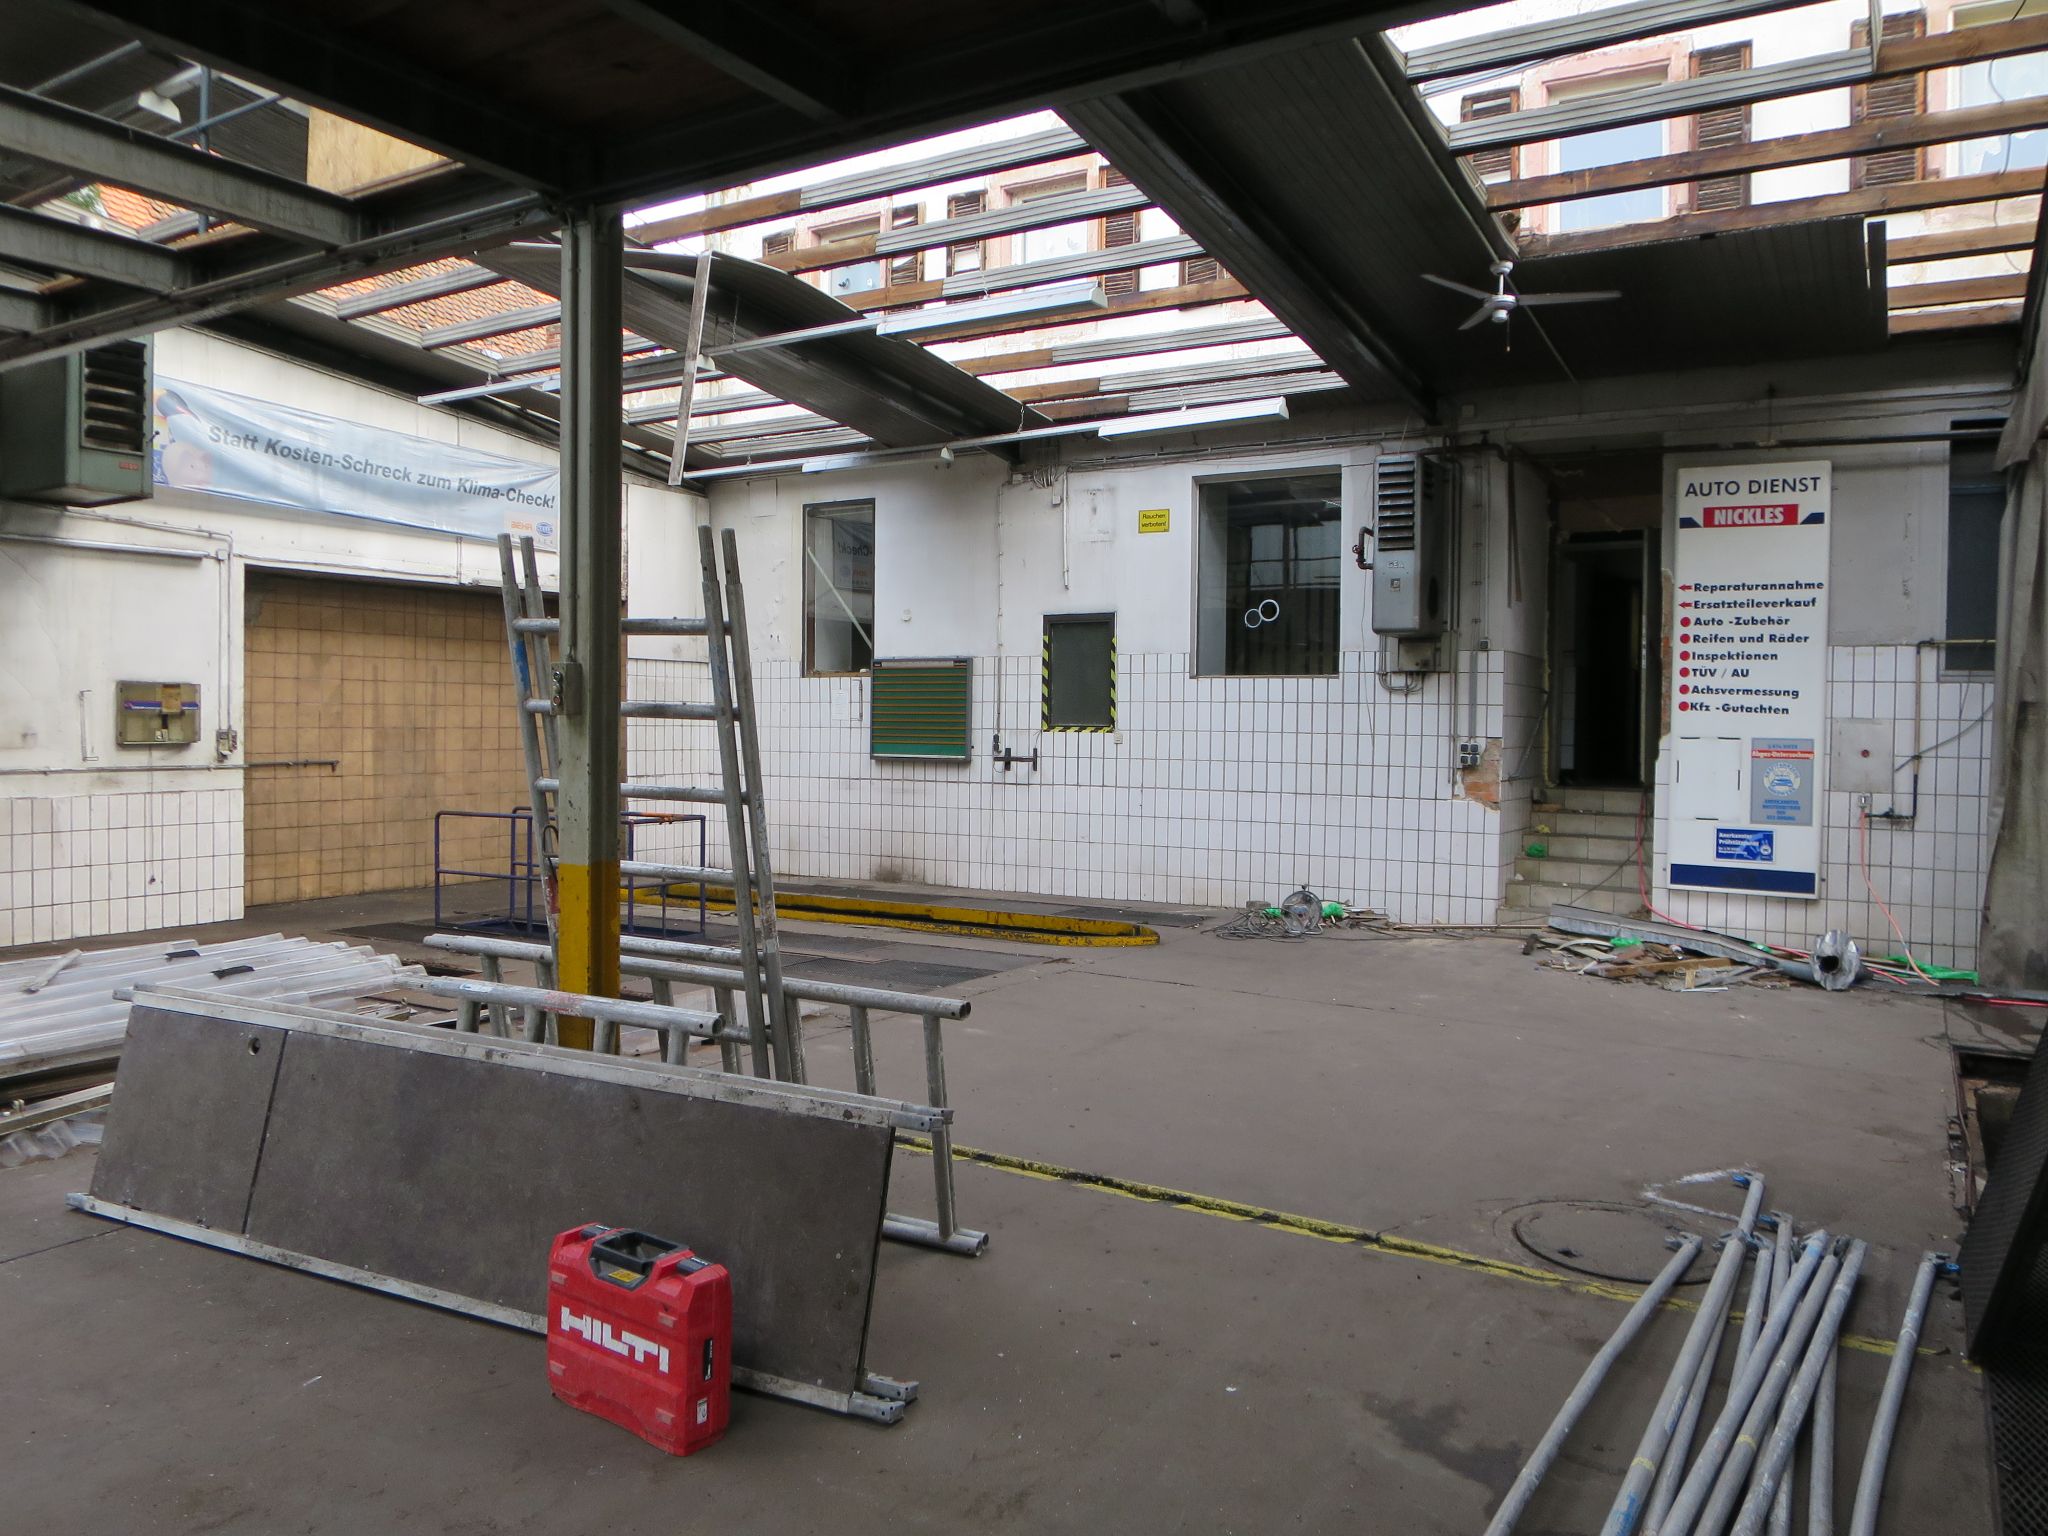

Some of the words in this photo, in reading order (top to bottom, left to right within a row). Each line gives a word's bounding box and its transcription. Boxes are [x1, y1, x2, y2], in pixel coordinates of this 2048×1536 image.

[208, 425, 259, 450] Statt
[264, 438, 412, 482] Kosten-Schreck
[417, 473, 451, 490] zum
[457, 477, 556, 509] Klima-Check!
[1685, 480, 1740, 497] AUTO
[1748, 476, 1821, 494] DIENST
[1713, 507, 1784, 525] NICKLES
[1694, 580, 1824, 594] Reparaturannahme
[1694, 597, 1817, 610] Ersatzteileverkauf
[1694, 616, 1724, 626] Auto
[1692, 633, 1735, 643] Reifen
[1739, 633, 1764, 643] und
[1769, 633, 1809, 643] Räder
[1692, 651, 1778, 662] Inspektionen
[1692, 665, 1717, 678] TÜV
[1731, 668, 1750, 678] AU
[1691, 685, 1800, 699] Achsvermessung
[1690, 702, 1711, 712] Kfz
[561, 1306, 670, 1374] HILTI
